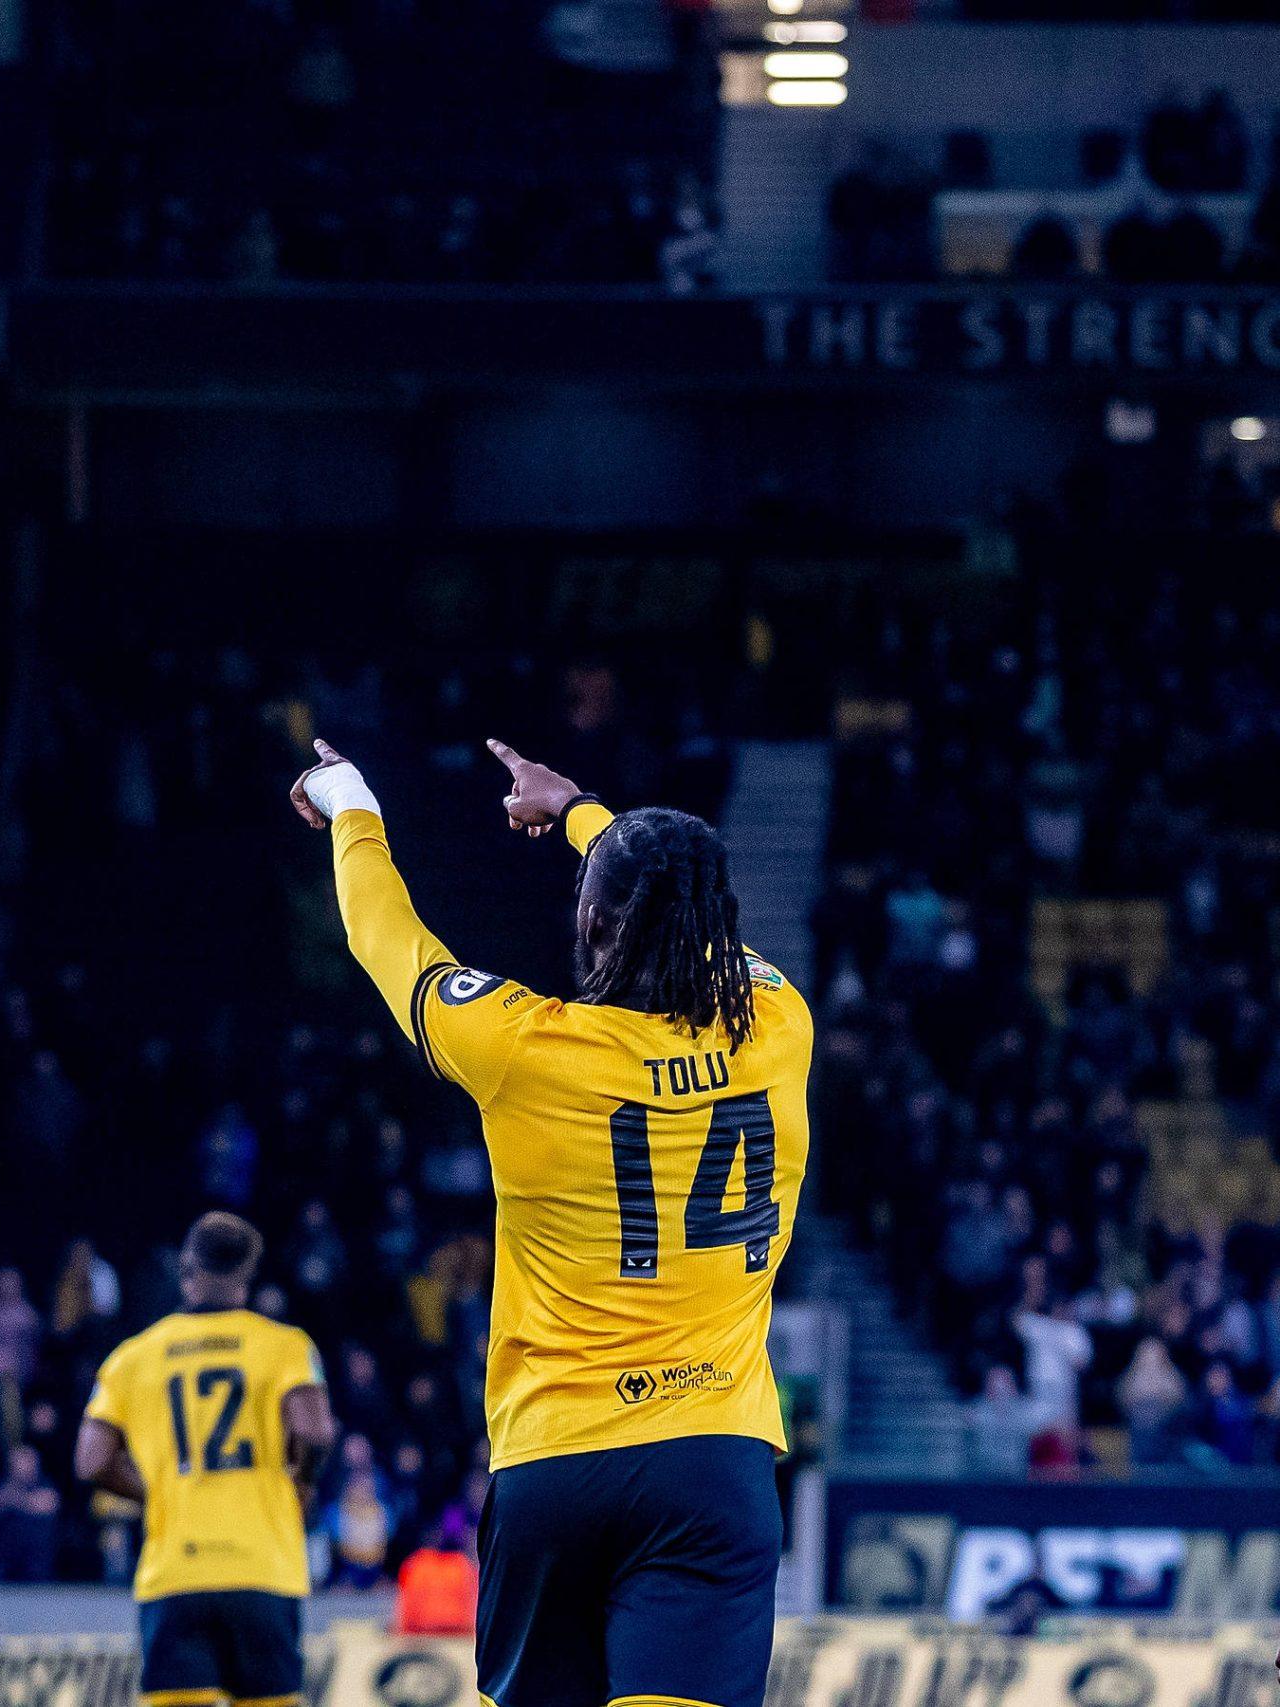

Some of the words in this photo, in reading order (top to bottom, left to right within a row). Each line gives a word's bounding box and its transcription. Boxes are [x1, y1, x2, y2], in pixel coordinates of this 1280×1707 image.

[758, 300, 918, 368] THE
[643, 1050, 730, 1096] TOLU
[610, 1089, 780, 1279] 14
[168, 1367, 254, 1476] 12
